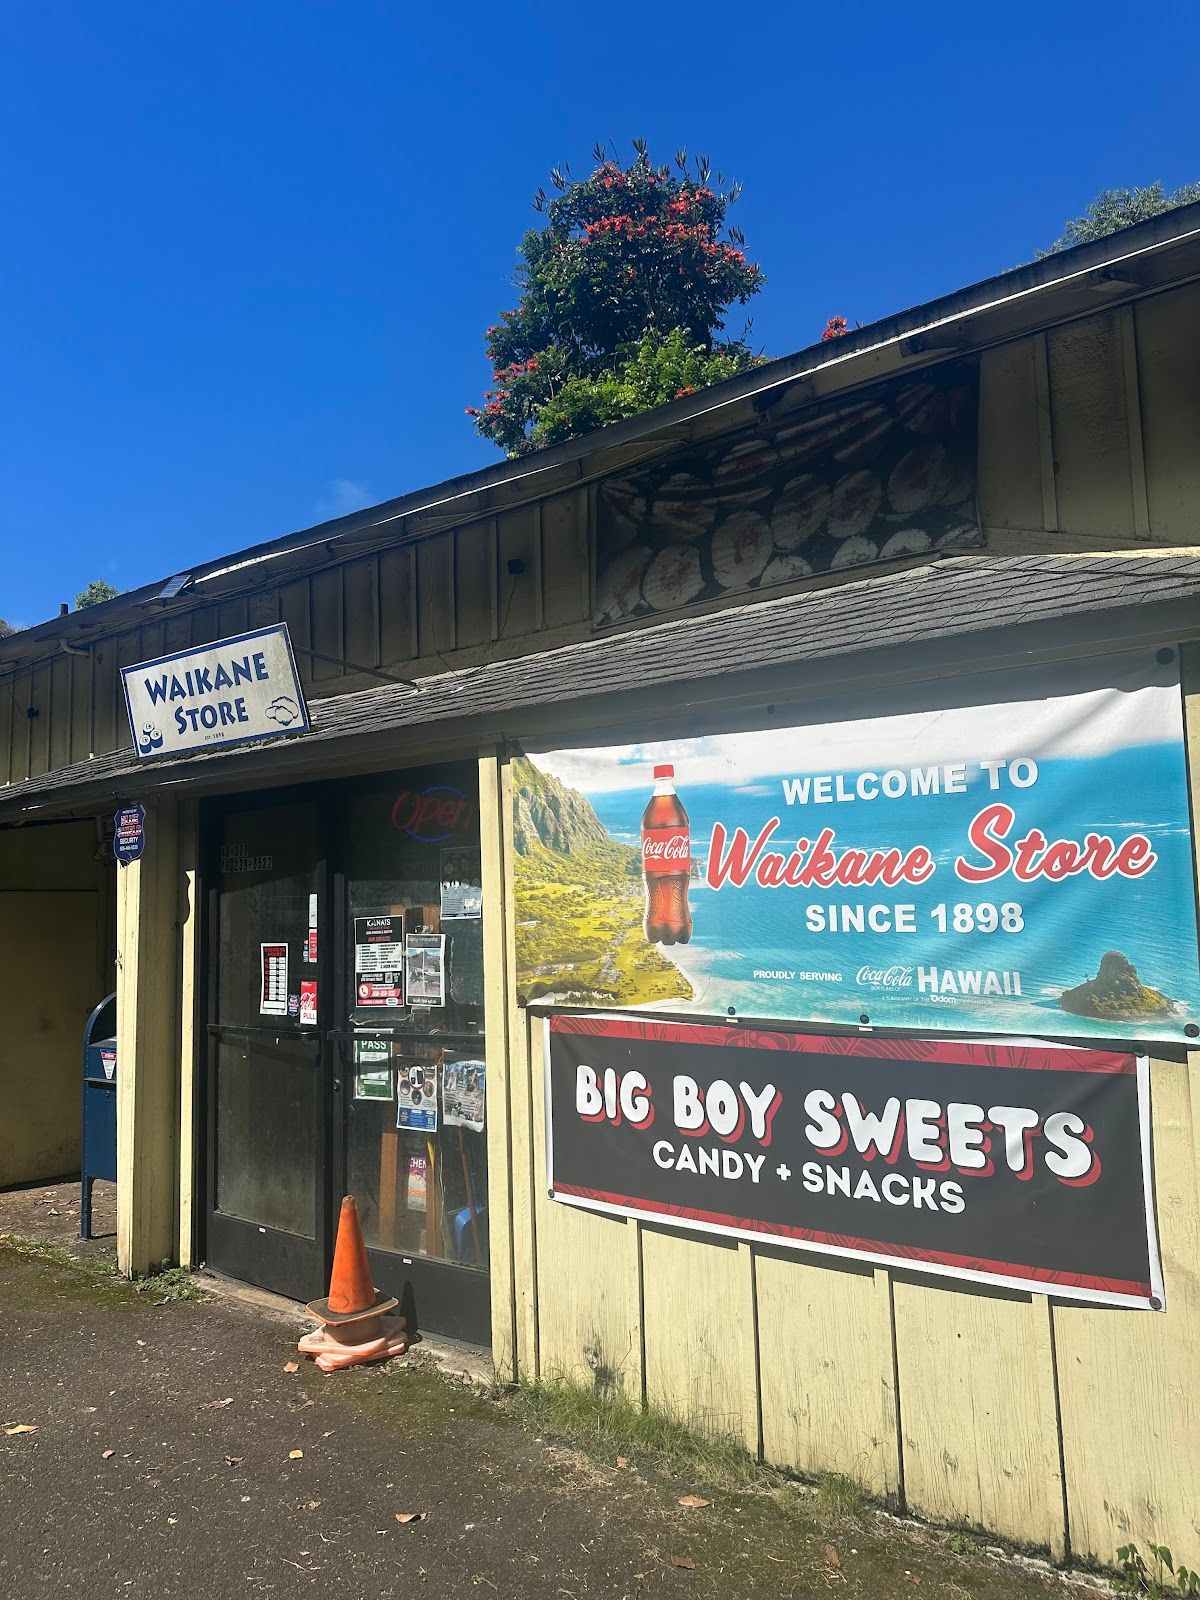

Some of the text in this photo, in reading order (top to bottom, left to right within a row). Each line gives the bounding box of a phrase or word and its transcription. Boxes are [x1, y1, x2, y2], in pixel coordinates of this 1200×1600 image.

[144, 652, 270, 706] WAIKANE
[174, 697, 250, 735] STORE
[782, 757, 1039, 806] WELCOME TO
[391, 791, 473, 834] Open
[119, 837, 139, 845] SECURITY
[642, 835, 689, 860] Coca-Cola
[705, 802, 1158, 891] Waikane Store
[805, 902, 1025, 933] SINCE 1898
[753, 970, 843, 982] PROUDLY SERVING
[855, 965, 1022, 996] Coca-Cola HAWAII
[930, 994, 957, 1003] Odom
[303, 1012, 316, 1020] PULL
[361, 1040, 387, 1049] PASS
[576, 1064, 1101, 1187] BIG BOY SWEETS
[652, 1140, 966, 1214] CANDY + SNACKS
